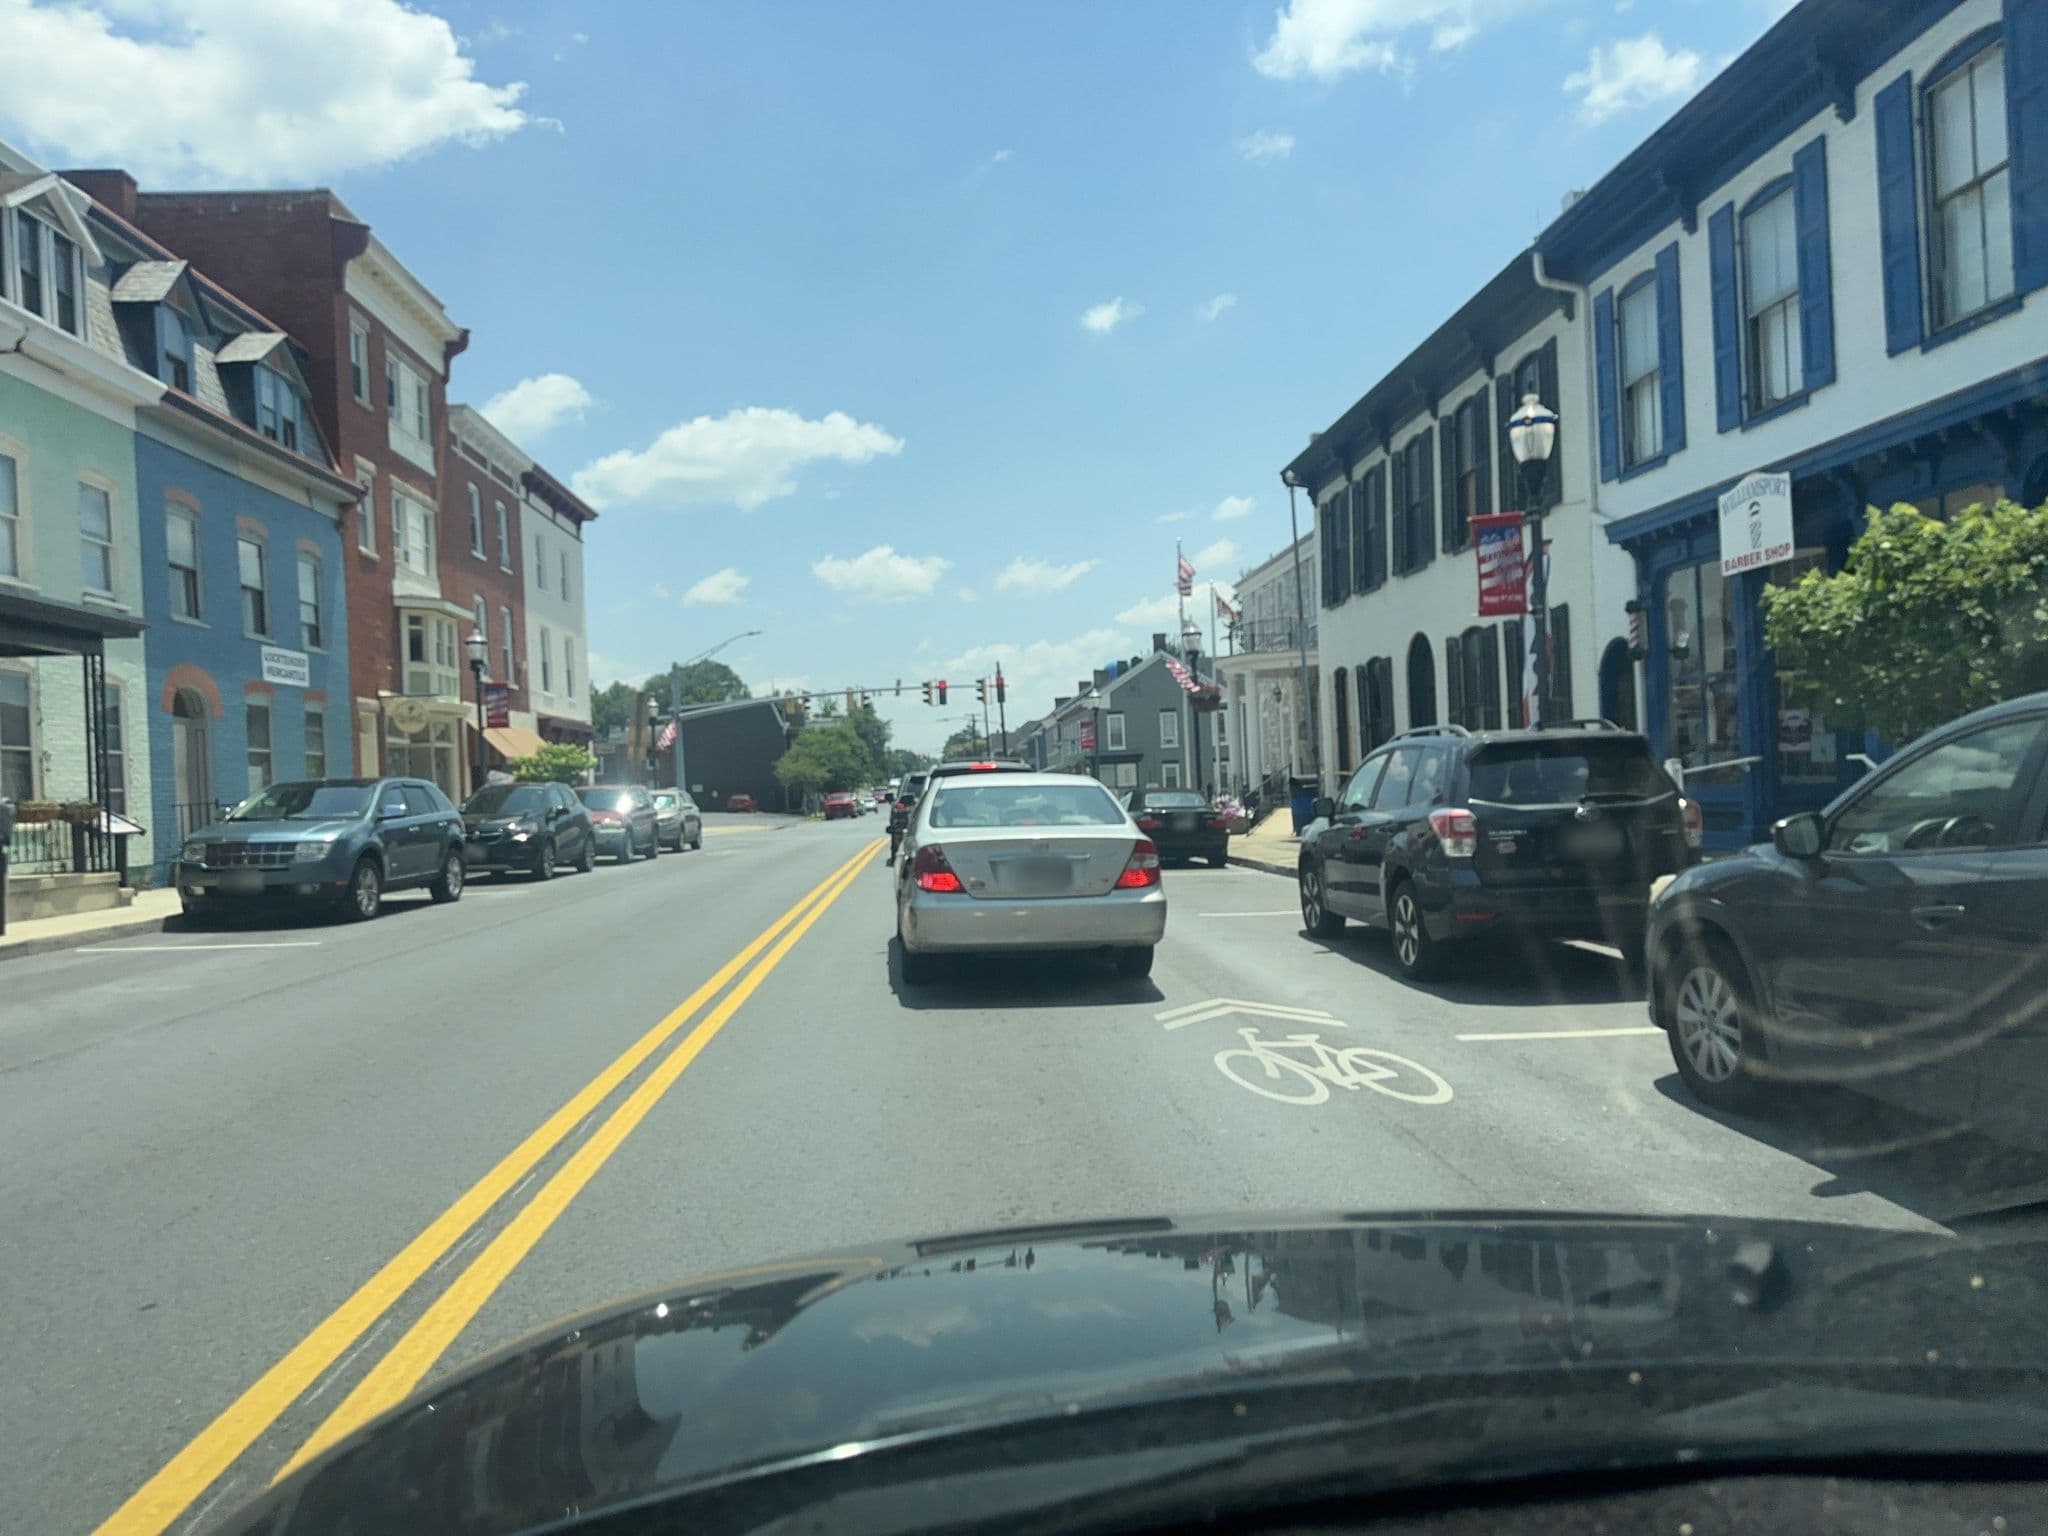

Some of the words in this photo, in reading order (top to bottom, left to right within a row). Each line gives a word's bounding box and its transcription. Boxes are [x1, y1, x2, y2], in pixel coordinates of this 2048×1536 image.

[1721, 478, 1787, 518] WILLIAMSPORT
[1724, 551, 1762, 573] BARBER
[1764, 542, 1791, 561] SHOP
